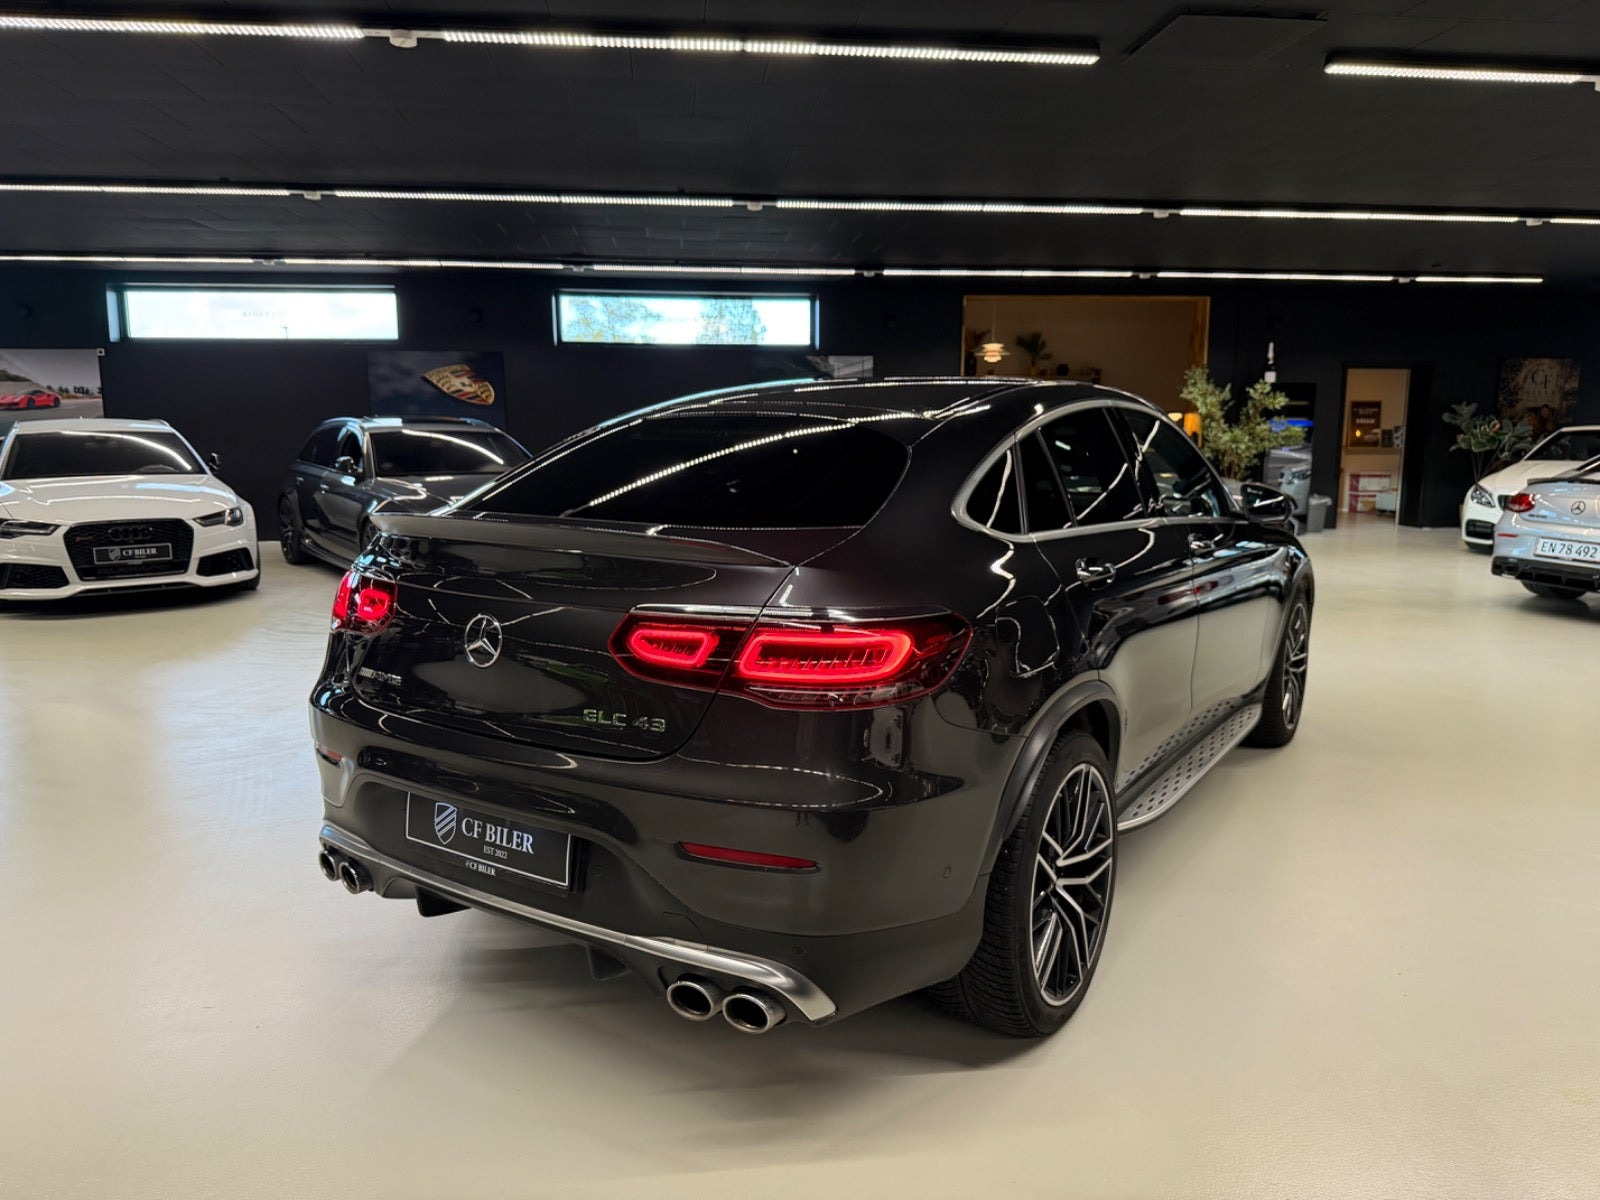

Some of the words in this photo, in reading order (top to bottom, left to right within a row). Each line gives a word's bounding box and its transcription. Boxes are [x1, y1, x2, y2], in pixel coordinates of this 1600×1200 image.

[1541, 541, 1557, 553] EN
[1558, 543, 1573, 555] 78
[1575, 545, 1598, 559] 492
[583, 708, 628, 727] GLC
[632, 716, 666, 732] 43
[462, 817, 483, 839] CF
[485, 823, 535, 855] BILER
[483, 845, 494, 856] EST
[495, 848, 509, 860] 2022
[478, 864, 496, 877] BILER
